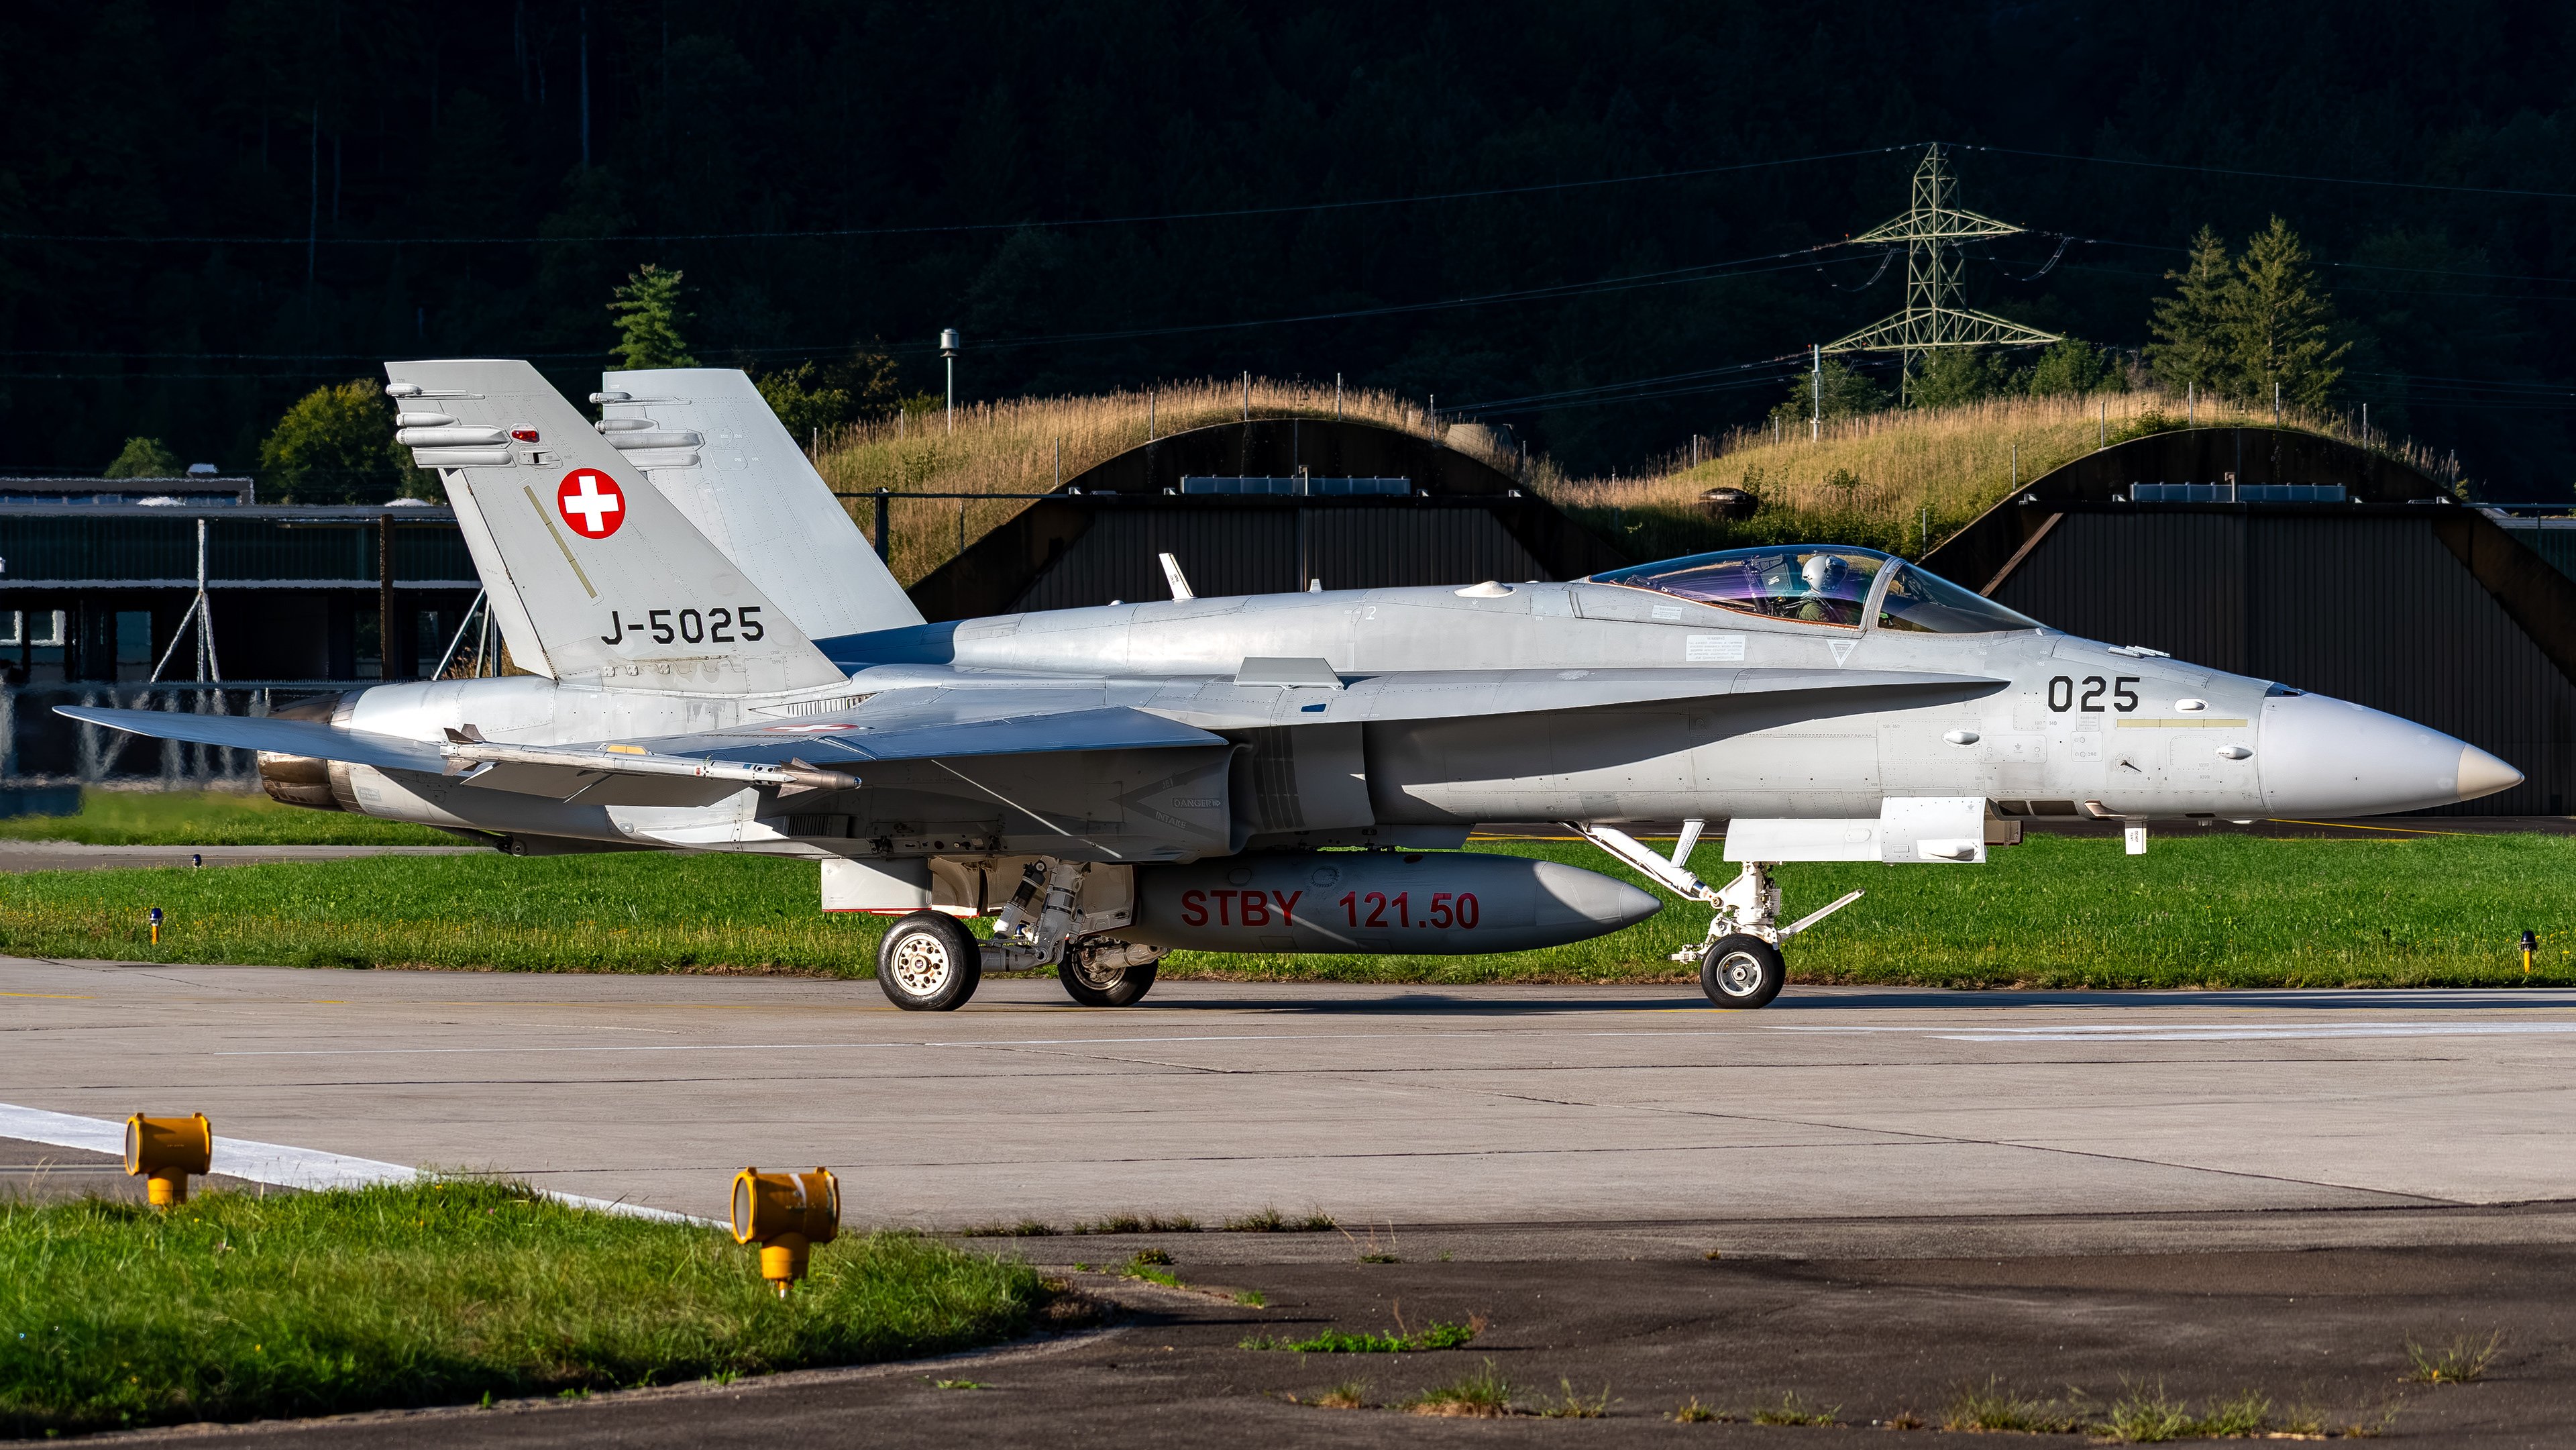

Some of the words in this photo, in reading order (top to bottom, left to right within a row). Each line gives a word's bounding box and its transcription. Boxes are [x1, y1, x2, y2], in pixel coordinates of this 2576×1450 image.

[601, 606, 764, 645] J-5025
[1365, 606, 1377, 620] 2
[2048, 675, 2140, 712] 025
[1174, 798, 1212, 808] DANGER
[1155, 811, 1187, 829] INTAKE
[1181, 889, 1303, 927] STBY
[1339, 891, 1480, 929] 121.50
